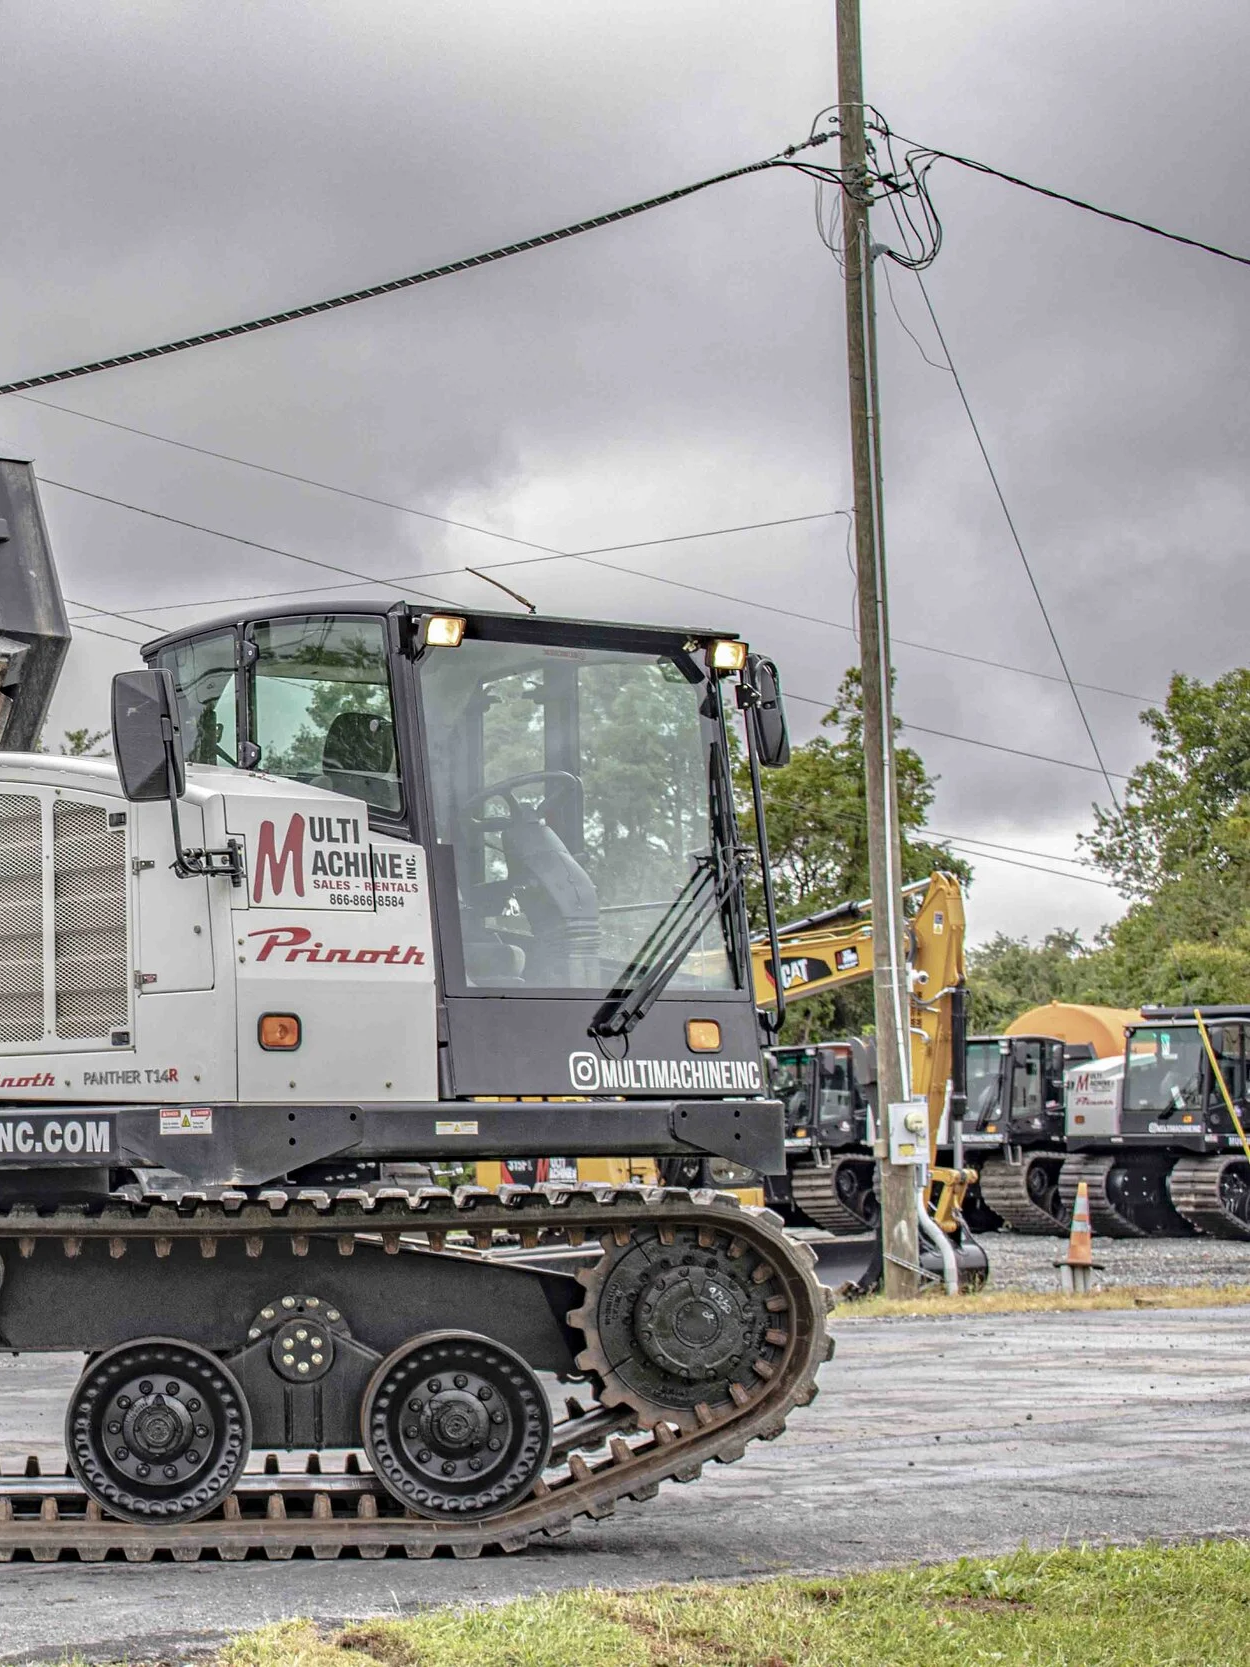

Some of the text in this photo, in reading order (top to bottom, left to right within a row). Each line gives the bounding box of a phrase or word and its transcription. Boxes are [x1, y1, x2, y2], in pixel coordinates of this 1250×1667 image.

[405, 853, 417, 880] INC.
[313, 879, 351, 891] SALES
[364, 880, 419, 893] RENTALS
[247, 926, 425, 965] Prinoth
[781, 958, 809, 989] CAT
[83, 1068, 178, 1086] PANTHER T14R
[601, 1058, 761, 1089] MULTIMACHINEINC
